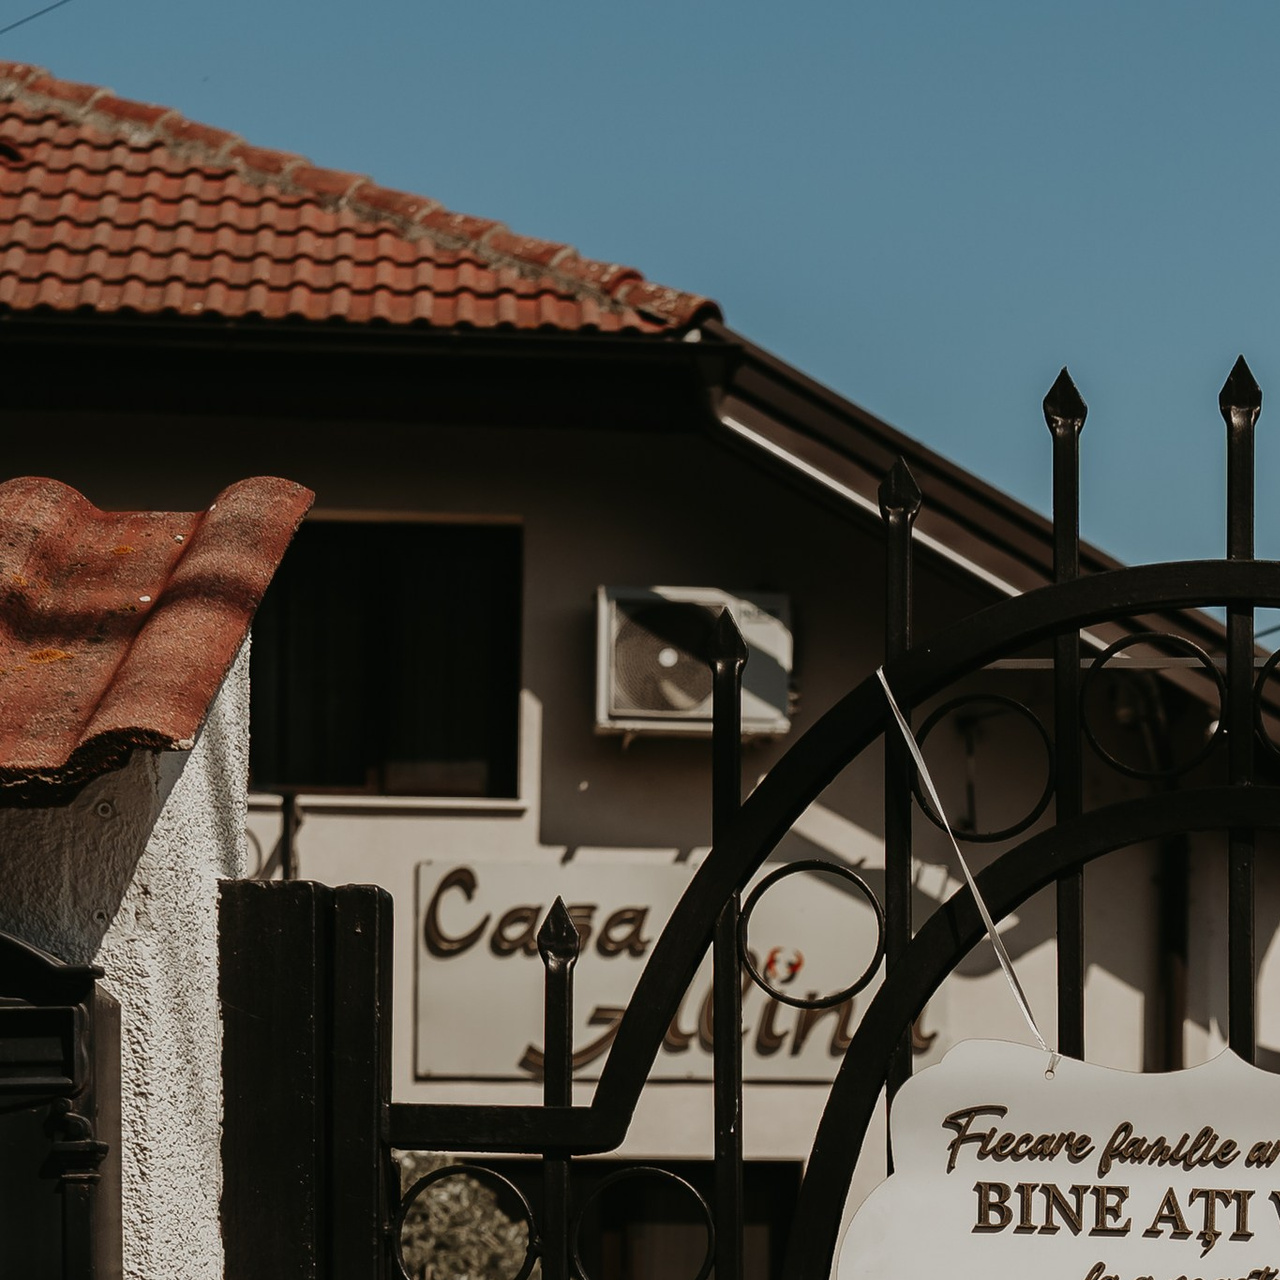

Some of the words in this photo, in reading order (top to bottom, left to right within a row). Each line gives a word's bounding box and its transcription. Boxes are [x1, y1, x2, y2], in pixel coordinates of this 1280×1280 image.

[942, 1104, 1096, 1175] Fiecare
[1097, 1120, 1241, 1178] familie
[971, 1181, 1131, 1237] BINE
[1141, 1186, 1256, 1259] AȚI
